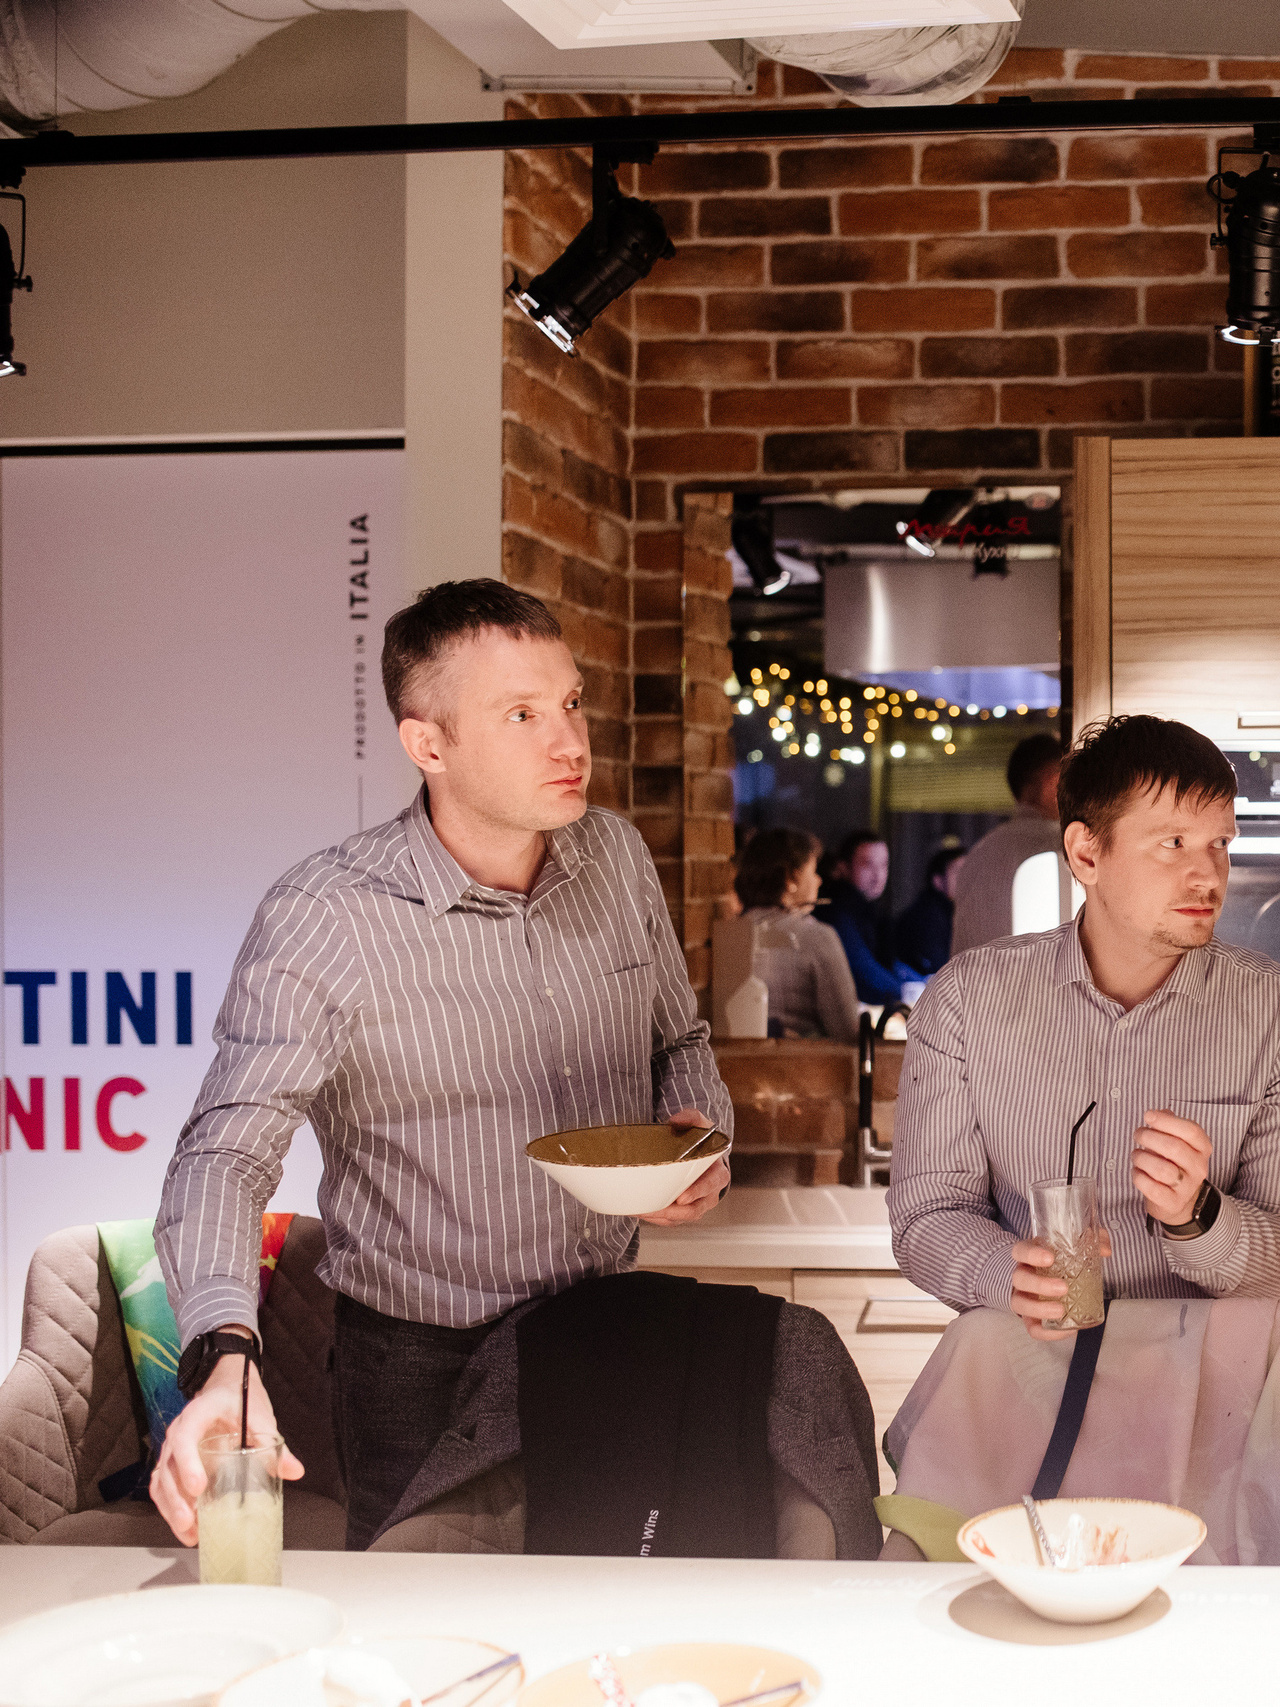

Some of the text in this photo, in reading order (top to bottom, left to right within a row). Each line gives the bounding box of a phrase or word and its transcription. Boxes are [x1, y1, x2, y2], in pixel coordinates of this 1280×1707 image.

[349, 513, 371, 620] ITALIA
[3, 971, 192, 1045] TINI
[641, 1509, 659, 1540] Wins
